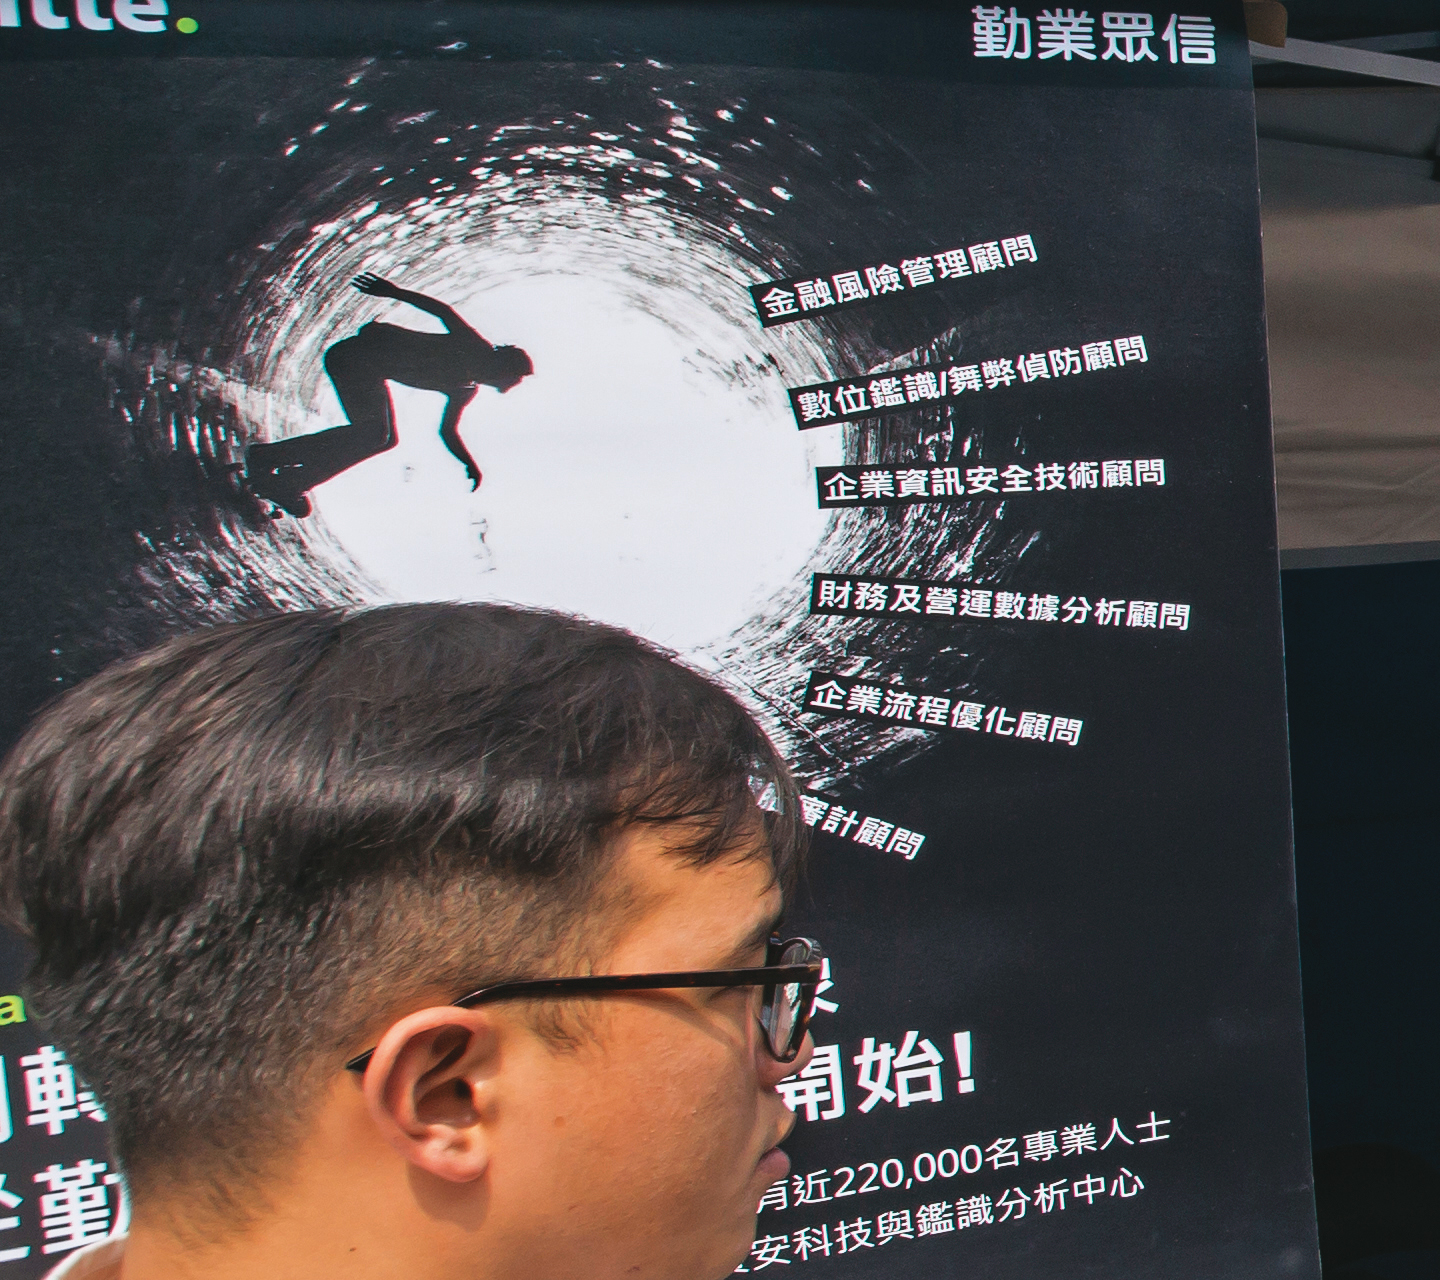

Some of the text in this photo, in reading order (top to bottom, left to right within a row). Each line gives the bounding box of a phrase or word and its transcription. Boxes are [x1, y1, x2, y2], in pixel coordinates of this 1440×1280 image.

[971, 4, 1217, 65] 勤業眾信
[760, 233, 1039, 320] 金融風險管理顧問
[797, 334, 1150, 422] 數位鑑識/舞弊偵防顧問
[823, 458, 1167, 501] 企業資訊安全技術顧問
[818, 579, 1192, 632] 財務及營運數據分析顧問
[809, 679, 1084, 747] 企業流程優化顧問
[733, 1166, 1146, 1274] 安科技與鑑識分析中心
